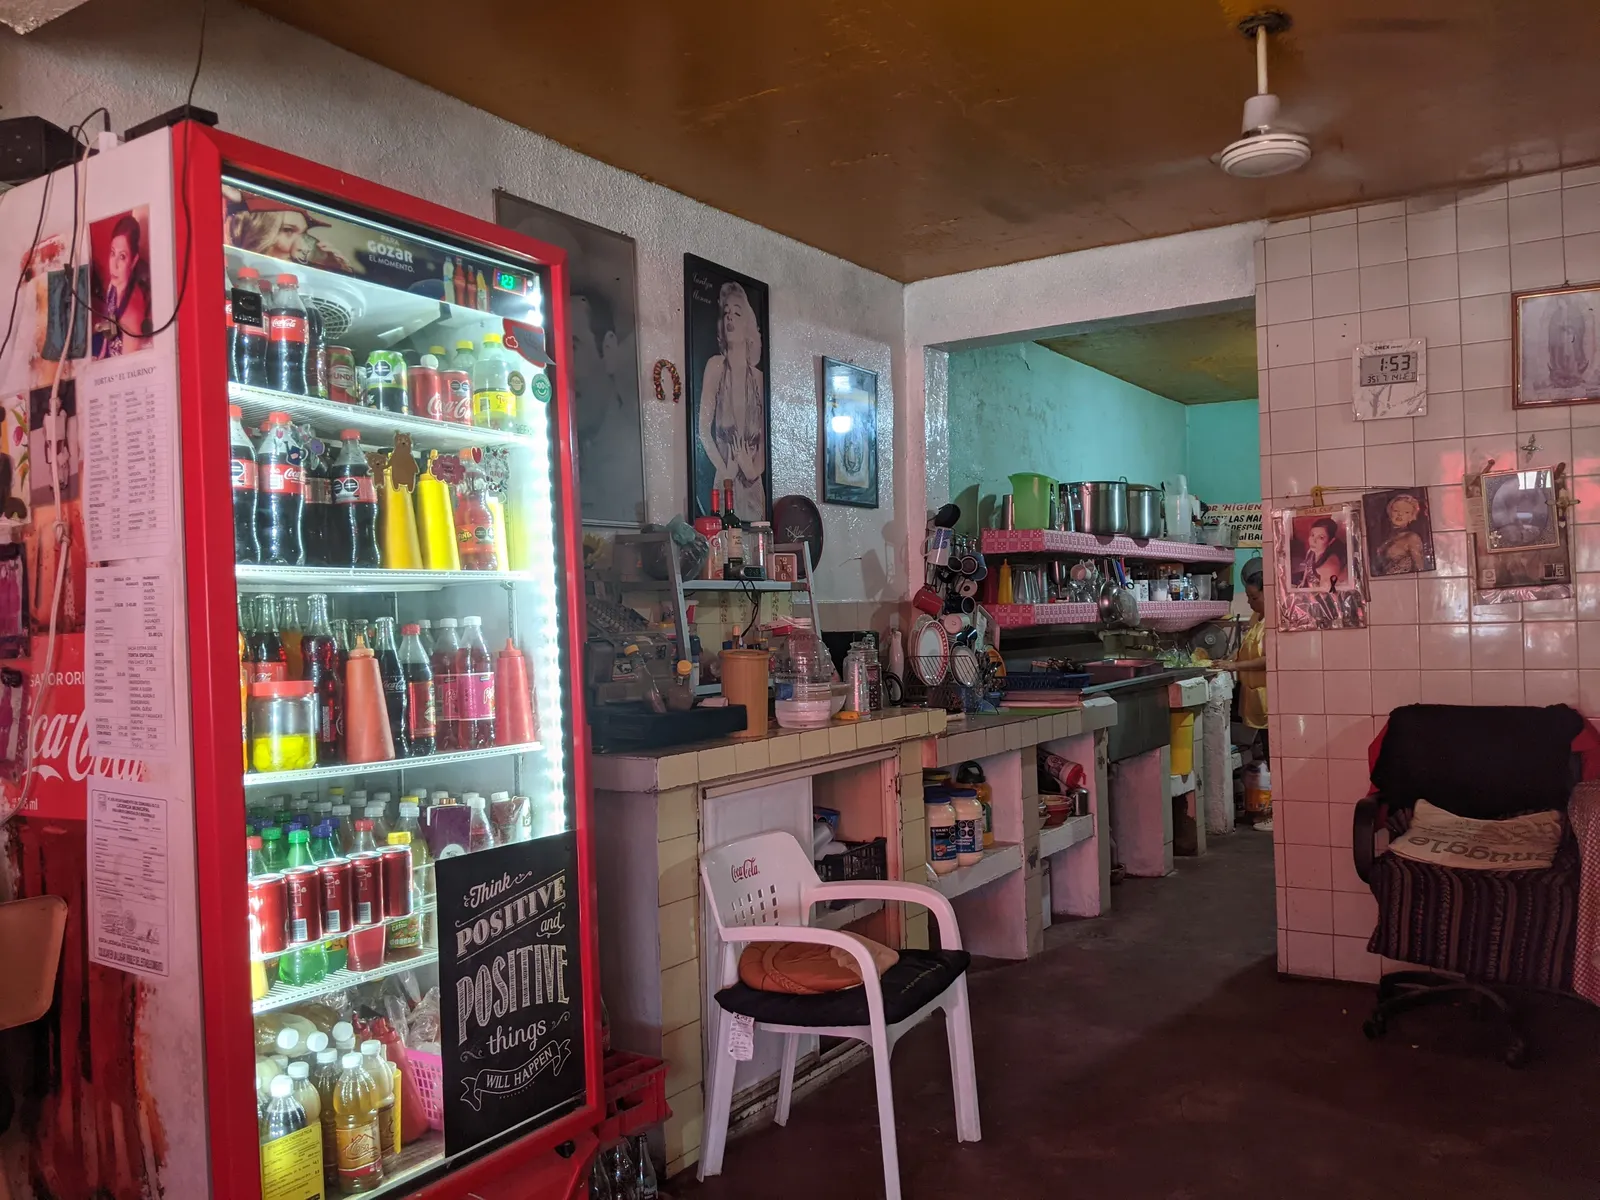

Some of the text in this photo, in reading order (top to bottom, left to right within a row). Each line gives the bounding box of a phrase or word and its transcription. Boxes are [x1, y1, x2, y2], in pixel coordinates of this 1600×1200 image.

[1380, 354, 1411, 372] 1:53
[1229, 514, 1245, 523] LAS
[1248, 533, 1262, 541] BA
[469, 872, 511, 909] Think
[456, 875, 566, 958] POSITIVE
[538, 911, 564, 935] and
[456, 944, 569, 1046] POSITIVE
[486, 1020, 547, 1055] things
[486, 1047, 553, 1090] WILL HAPPEN
